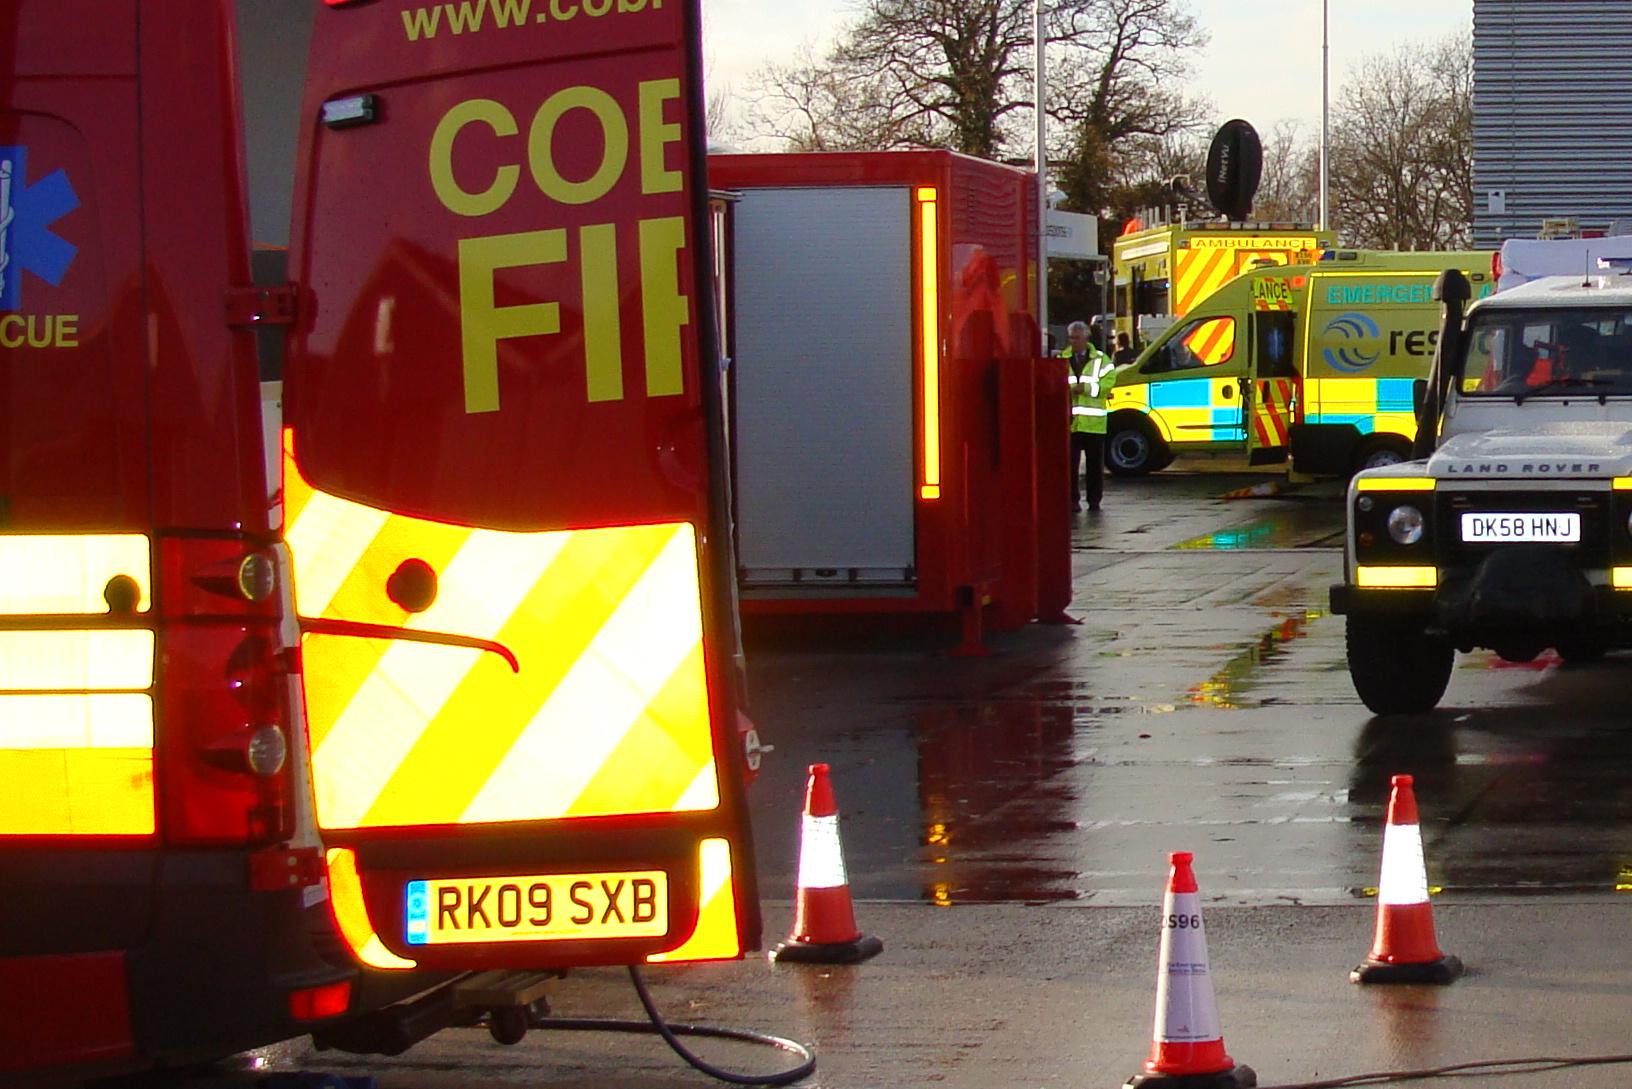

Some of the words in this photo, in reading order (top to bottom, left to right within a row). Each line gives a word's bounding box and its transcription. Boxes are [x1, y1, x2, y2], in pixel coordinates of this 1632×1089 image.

[1196, 239, 1313, 248] AMBULANCE
[1448, 464, 1508, 473] LAND
[1522, 464, 1600, 472] ROVER
[1473, 518, 1525, 537] DK58
[1532, 518, 1571, 537] HNJ
[438, 884, 552, 930] RK09
[570, 879, 656, 924] SXB
